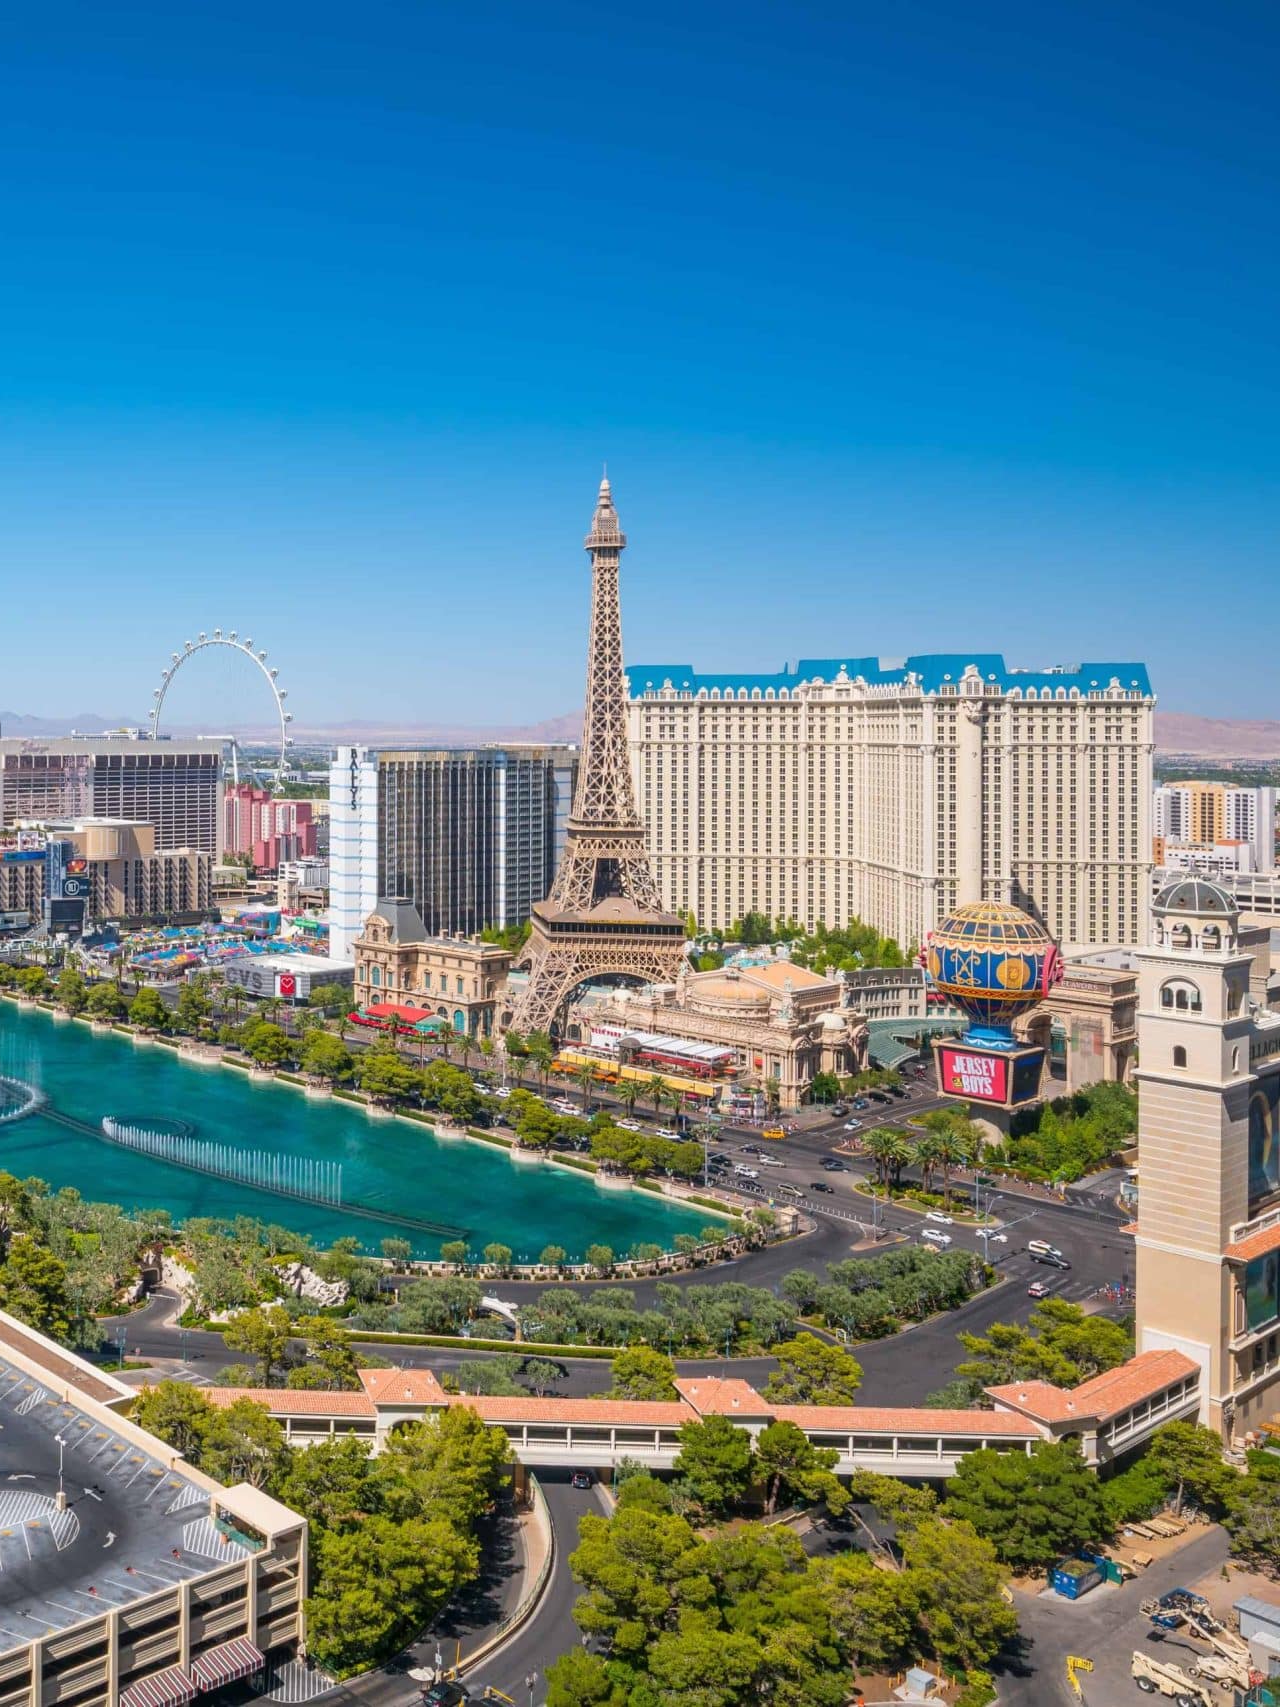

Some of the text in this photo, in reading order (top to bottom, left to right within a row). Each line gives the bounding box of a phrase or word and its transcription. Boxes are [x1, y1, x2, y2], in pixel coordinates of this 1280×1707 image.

[225, 966, 263, 989] CVS
[952, 1055, 996, 1077] JERSEY
[961, 1074, 993, 1095] BOYS
